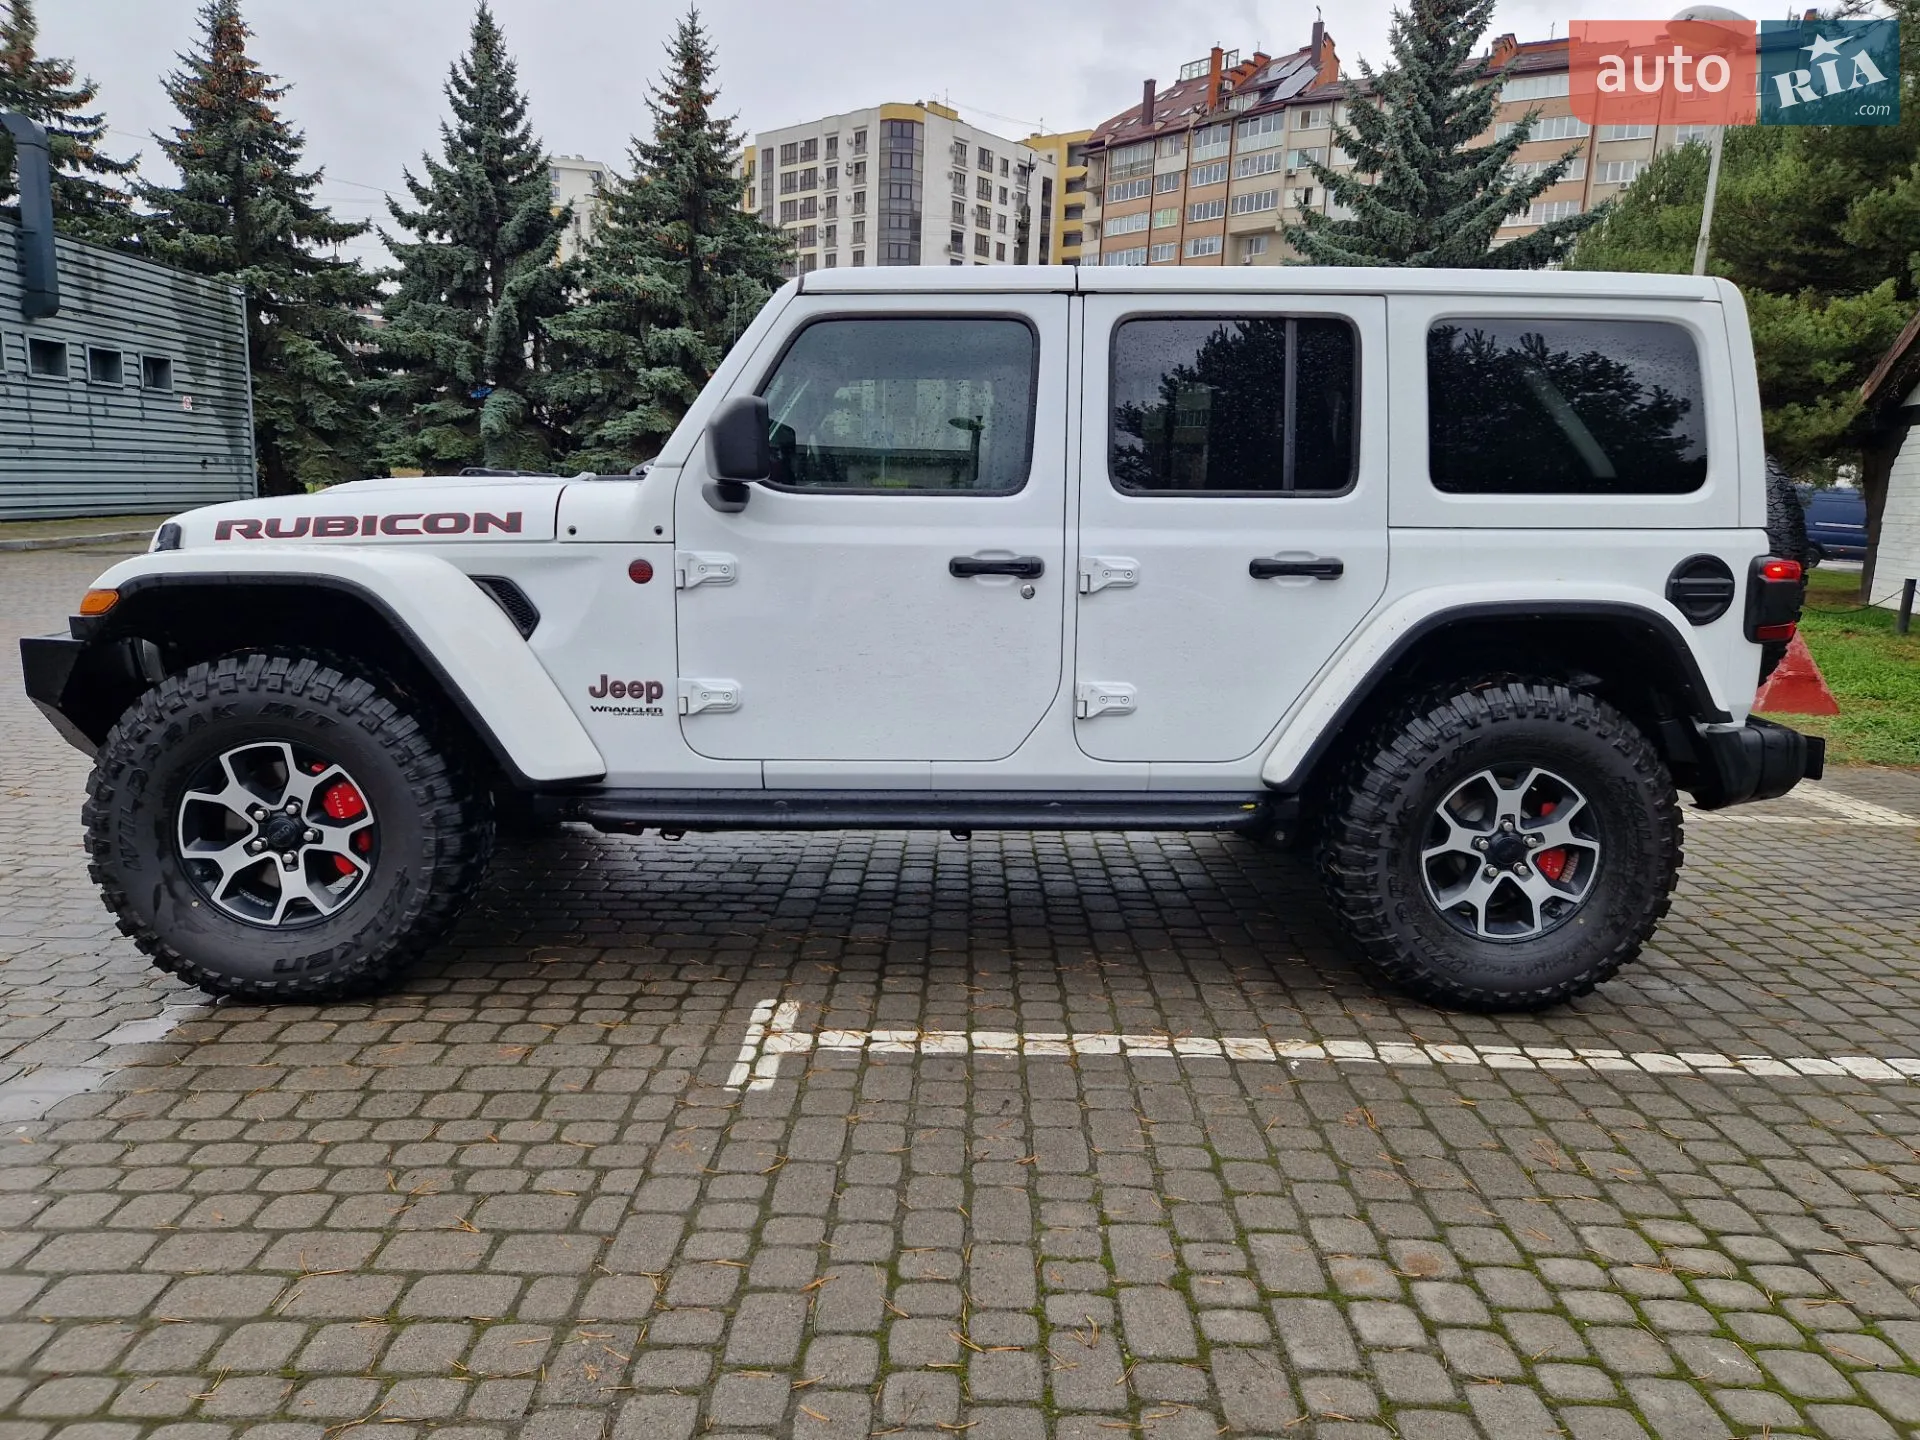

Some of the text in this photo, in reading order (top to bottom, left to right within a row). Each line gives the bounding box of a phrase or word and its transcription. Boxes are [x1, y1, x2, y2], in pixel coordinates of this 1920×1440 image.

[214, 511, 523, 541] RUBICON
[588, 673, 664, 704] Jeep
[590, 705, 663, 714] WRANGLER
